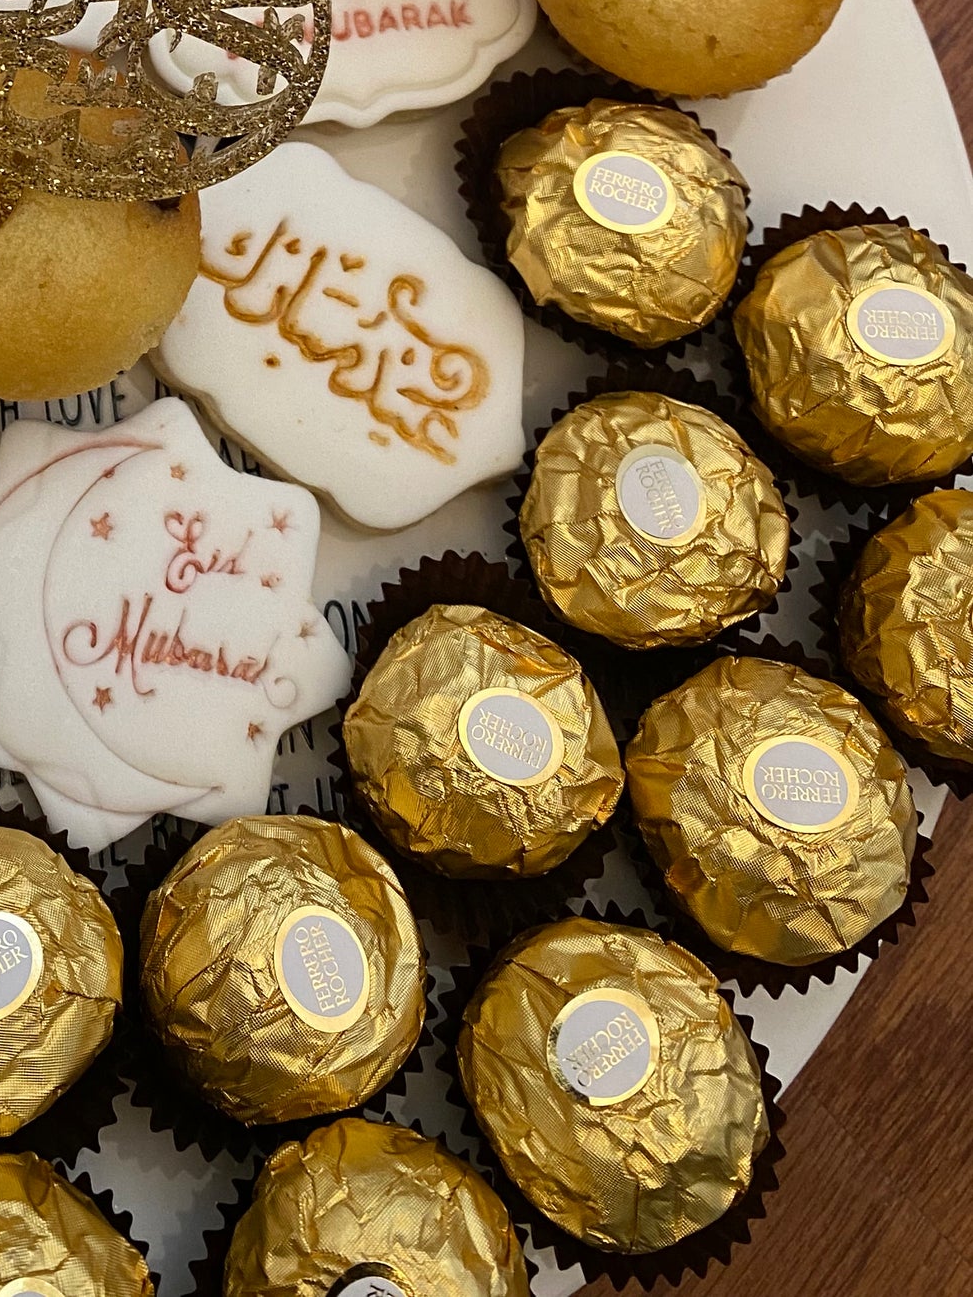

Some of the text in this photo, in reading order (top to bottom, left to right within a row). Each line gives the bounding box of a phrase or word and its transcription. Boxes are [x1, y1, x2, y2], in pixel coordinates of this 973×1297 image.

[588, 179, 659, 214] ROCHER
[593, 166, 664, 199] FERRERO
[862, 308, 938, 327] ROCHER
[864, 323, 940, 341] FERRERO
[164, 510, 254, 594] Eid
[471, 724, 543, 769] FERRERO
[478, 707, 548, 754] ROCHER
[759, 765, 841, 788] ROCHER
[761, 783, 842, 805] FERRERO
[294, 926, 336, 1013] FERRERO
[309, 920, 351, 1007] ROCHER
